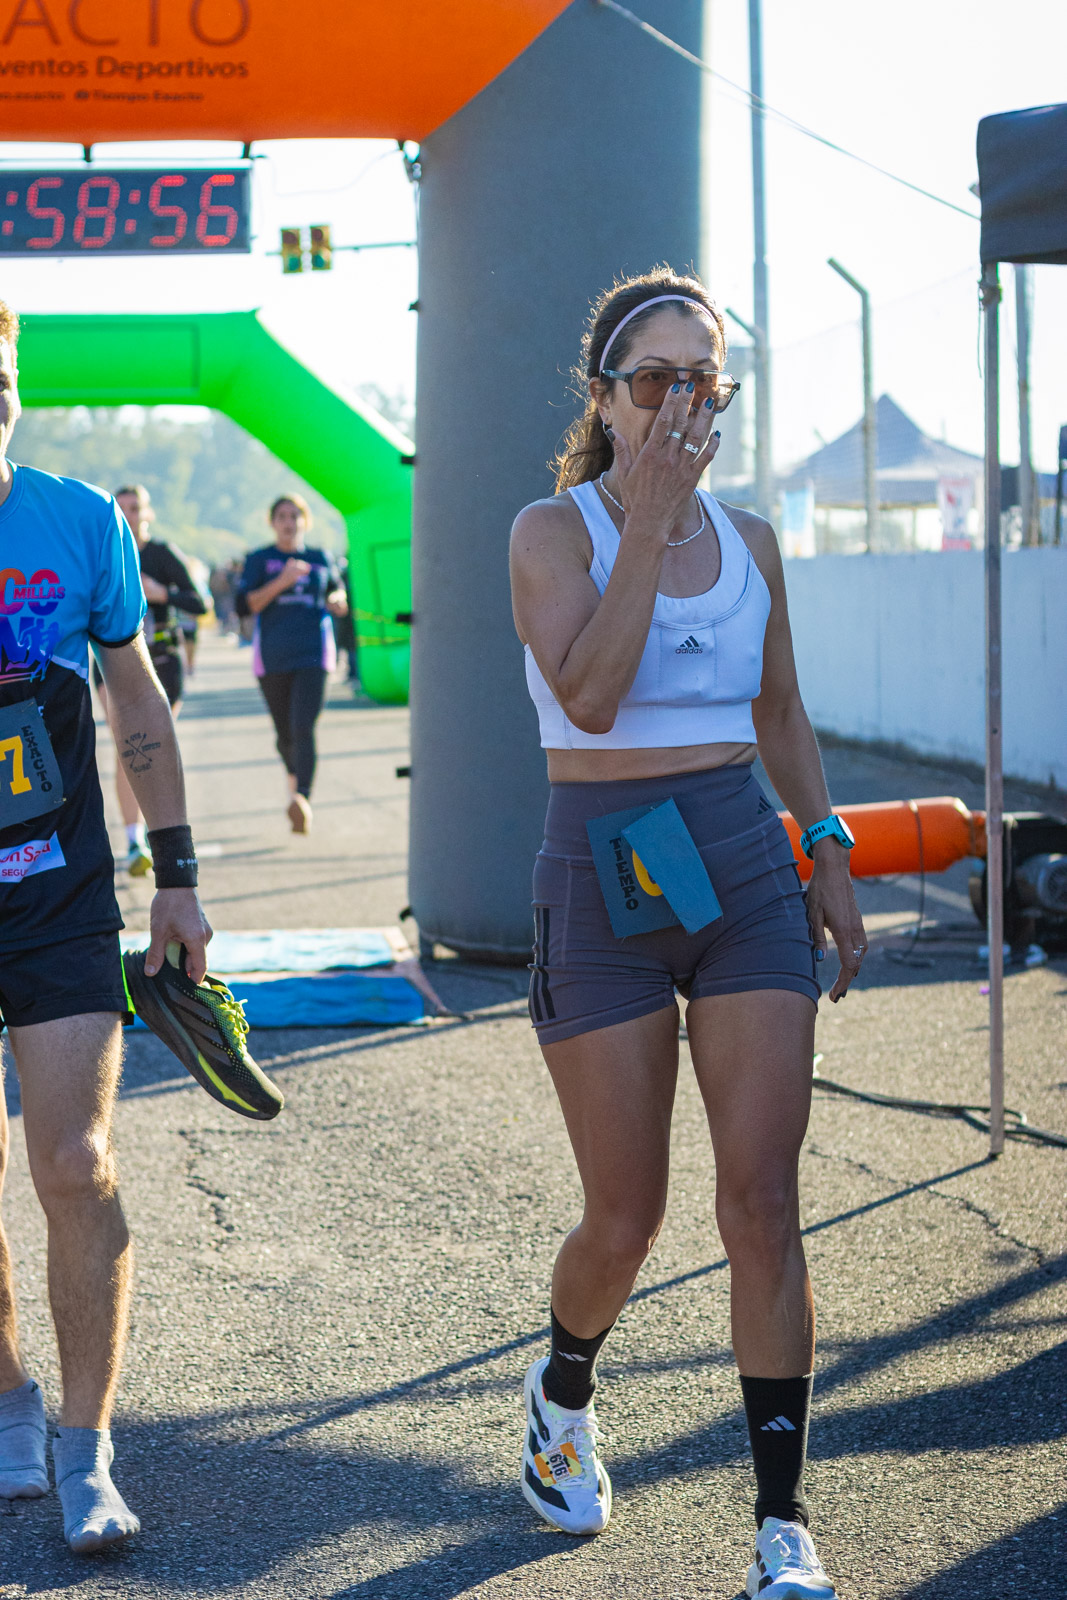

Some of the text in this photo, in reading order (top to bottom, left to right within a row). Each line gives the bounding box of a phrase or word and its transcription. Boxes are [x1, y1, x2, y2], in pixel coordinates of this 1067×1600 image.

[96, 55, 249, 80] Deportivos
[13, 586, 66, 599] MILLAS
[675, 647, 703, 655] adidas
[21, 724, 53, 793] EXACTO
[609, 837, 639, 911] TIEMPO
[550, 1453, 567, 1476] 616
